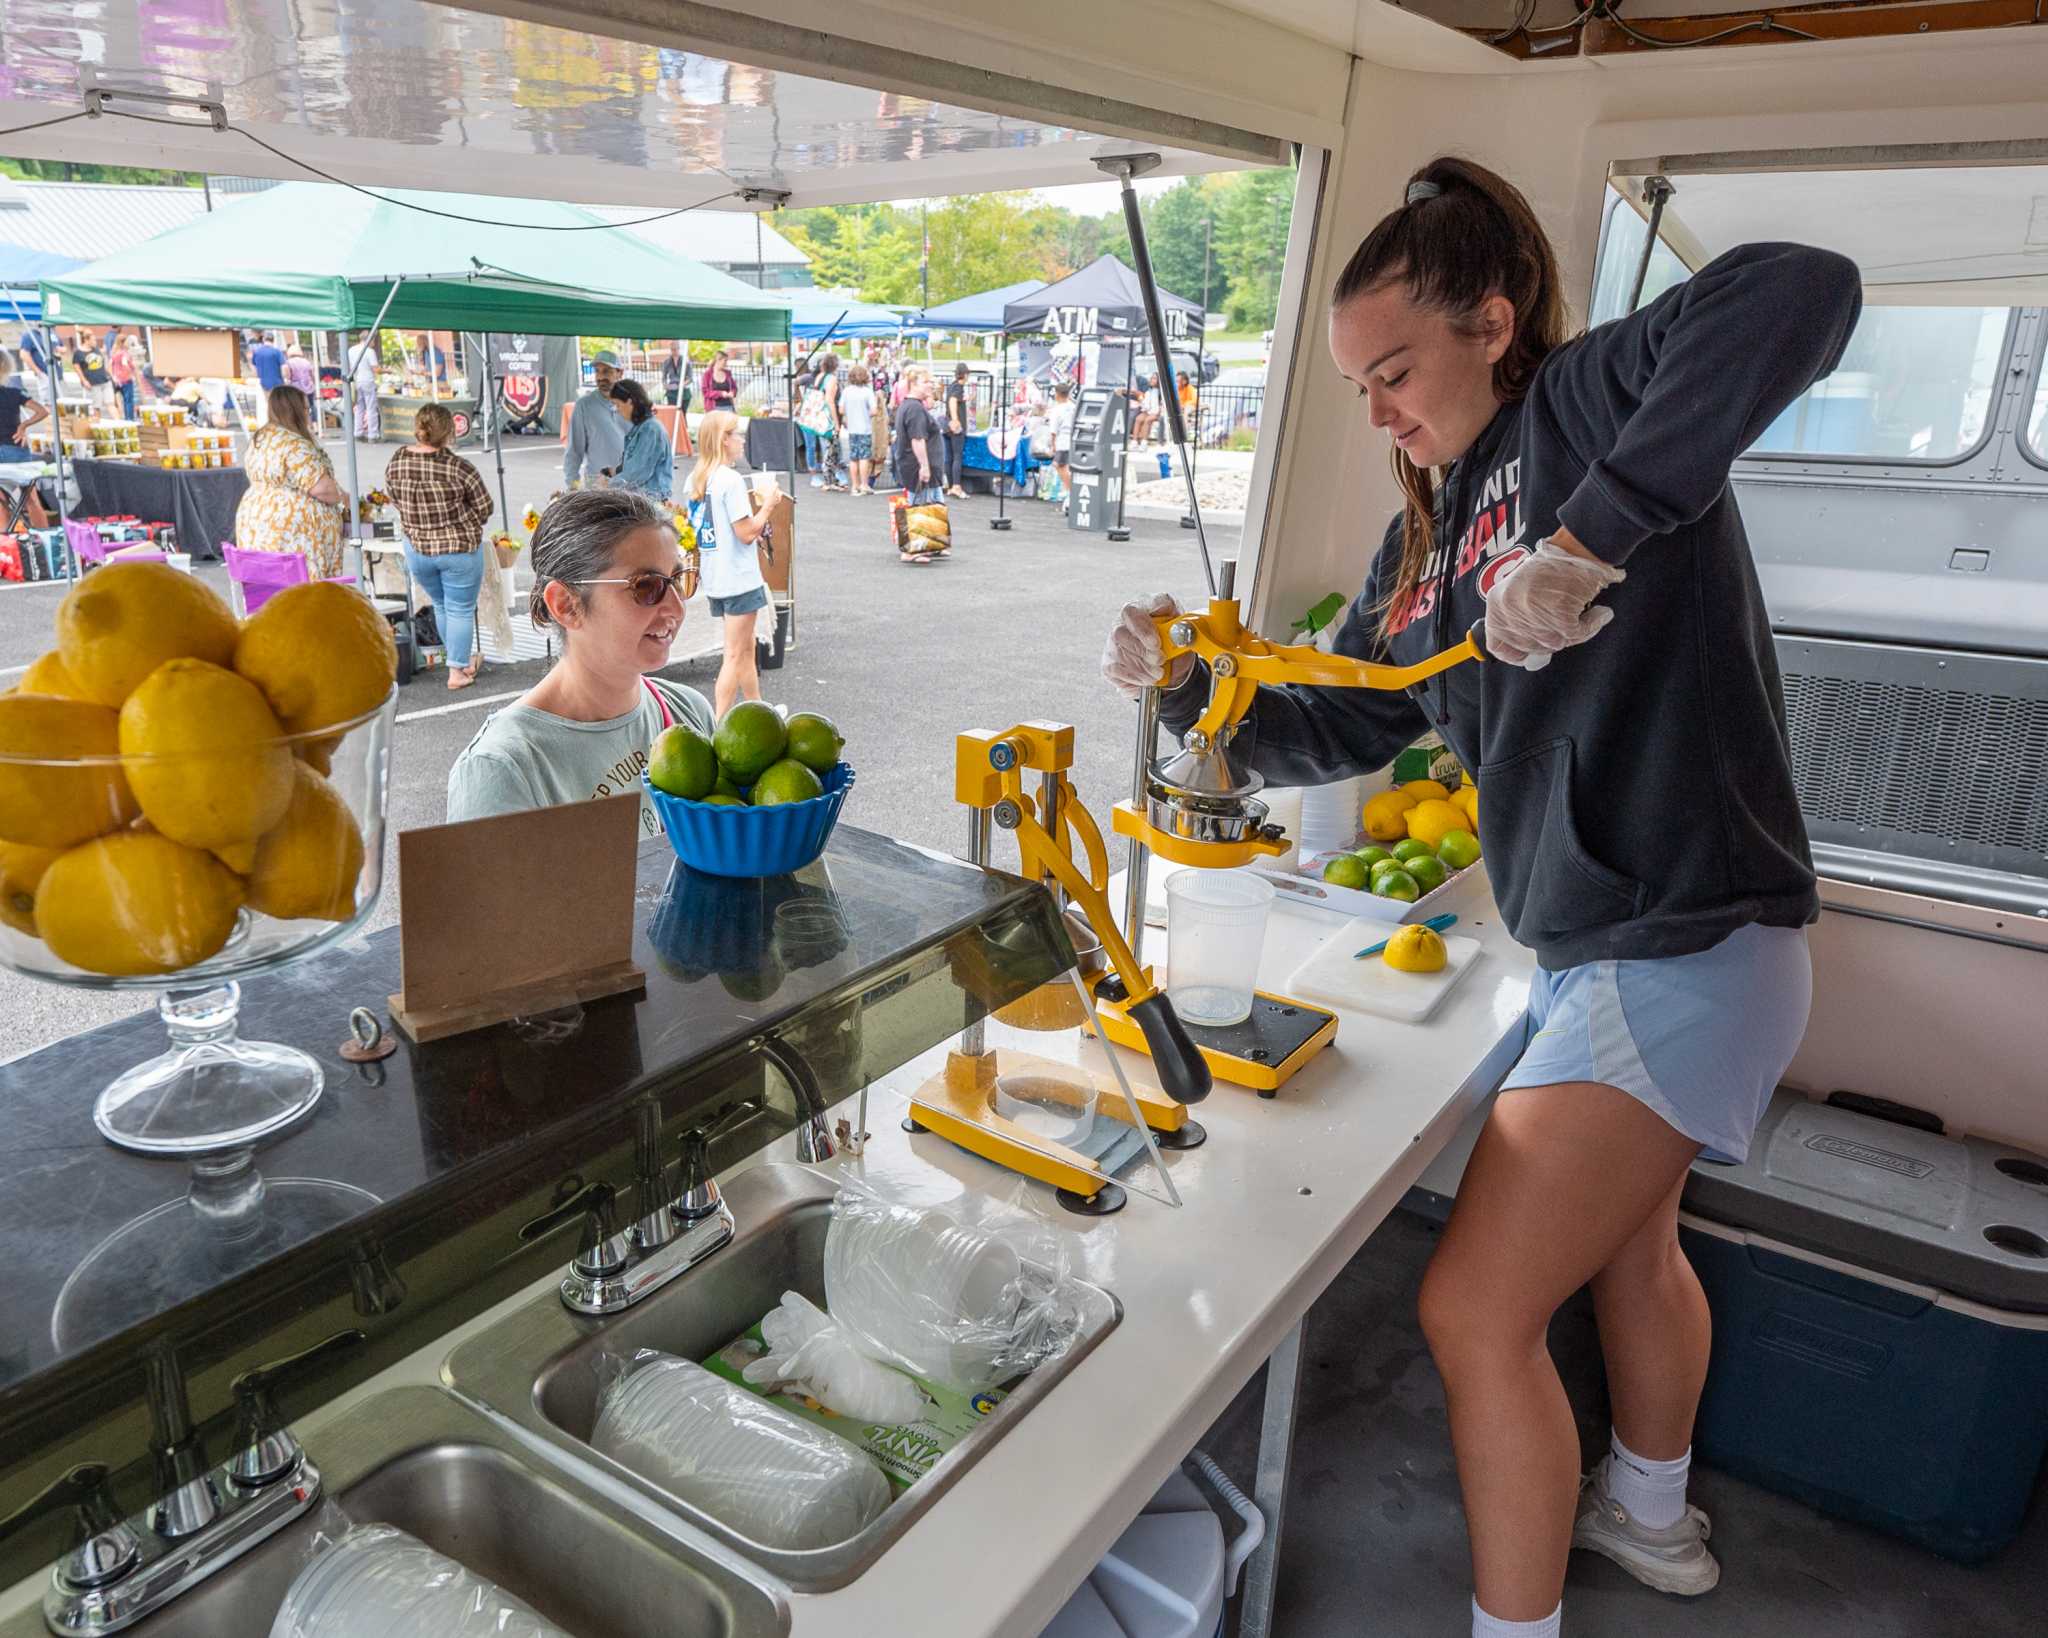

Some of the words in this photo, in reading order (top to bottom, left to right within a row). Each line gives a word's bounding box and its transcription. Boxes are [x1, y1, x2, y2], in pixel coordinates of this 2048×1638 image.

[1042, 307, 1100, 335] ATM
[1163, 309, 1189, 336] TM
[1106, 409, 1126, 502] ATM
[1077, 484, 1091, 527] ATM
[606, 751, 648, 788] YOUR
[870, 1424, 943, 1467] VINYL
[896, 1425, 939, 1447] GLOVES
